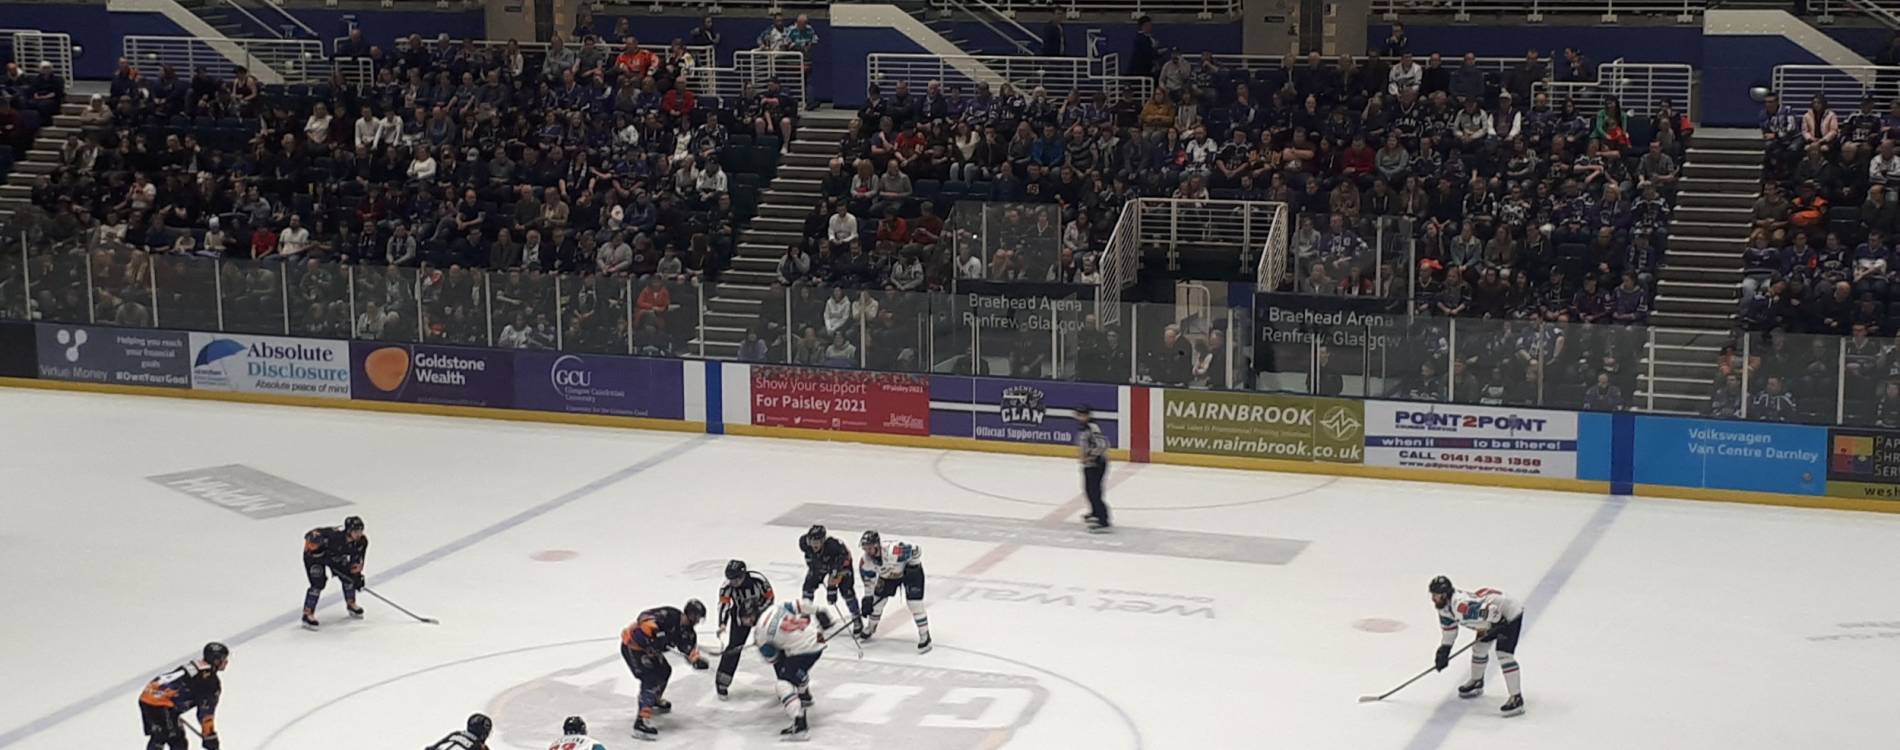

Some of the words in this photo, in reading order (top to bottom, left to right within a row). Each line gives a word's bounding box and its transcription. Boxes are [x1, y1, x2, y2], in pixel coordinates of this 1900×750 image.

[968, 293, 1036, 311] Braehead
[1039, 296, 1082, 312] Aena
[1028, 315, 1085, 334] Glagow
[1269, 307, 1342, 325] Braehead
[1346, 311, 1393, 327] Arena
[247, 341, 334, 362] Absolute
[414, 353, 485, 371] Goldstone
[73, 367, 108, 382] Money
[116, 371, 189, 385] #OwnYourGoal
[247, 361, 349, 382] Disclosure
[415, 368, 466, 385] Wealth
[556, 370, 592, 387] GCU
[256, 379, 291, 391] Absolute
[292, 383, 316, 393] peace
[318, 382, 327, 393] of
[328, 383, 348, 395] mind
[755, 378, 788, 391] Show
[791, 380, 818, 394] your
[819, 382, 866, 396] support
[755, 394, 779, 407] For
[782, 394, 832, 413] Paisley
[834, 398, 867, 413] 2021
[1001, 407, 1045, 424] CLAN
[1166, 400, 1315, 427] NAIRNBROOK
[976, 425, 1006, 437] Official
[1007, 427, 1052, 442] Supporters
[1053, 430, 1072, 442] Club
[1688, 427, 1771, 445] Volkswagen
[1166, 435, 1361, 461] www.nairnbrook.co.uk
[1381, 437, 1422, 447] when
[1425, 437, 1435, 447] it
[1473, 440, 1488, 448] to
[1491, 440, 1512, 449] be
[1514, 440, 1561, 451] there!
[1398, 450, 1436, 461] CALL
[1440, 453, 1469, 463] 0141
[1474, 455, 1503, 465] 433
[1688, 443, 1715, 455] Van
[1717, 445, 1762, 459] Centre
[1765, 447, 1819, 464] Darnley
[1874, 464, 1900, 477] SER
